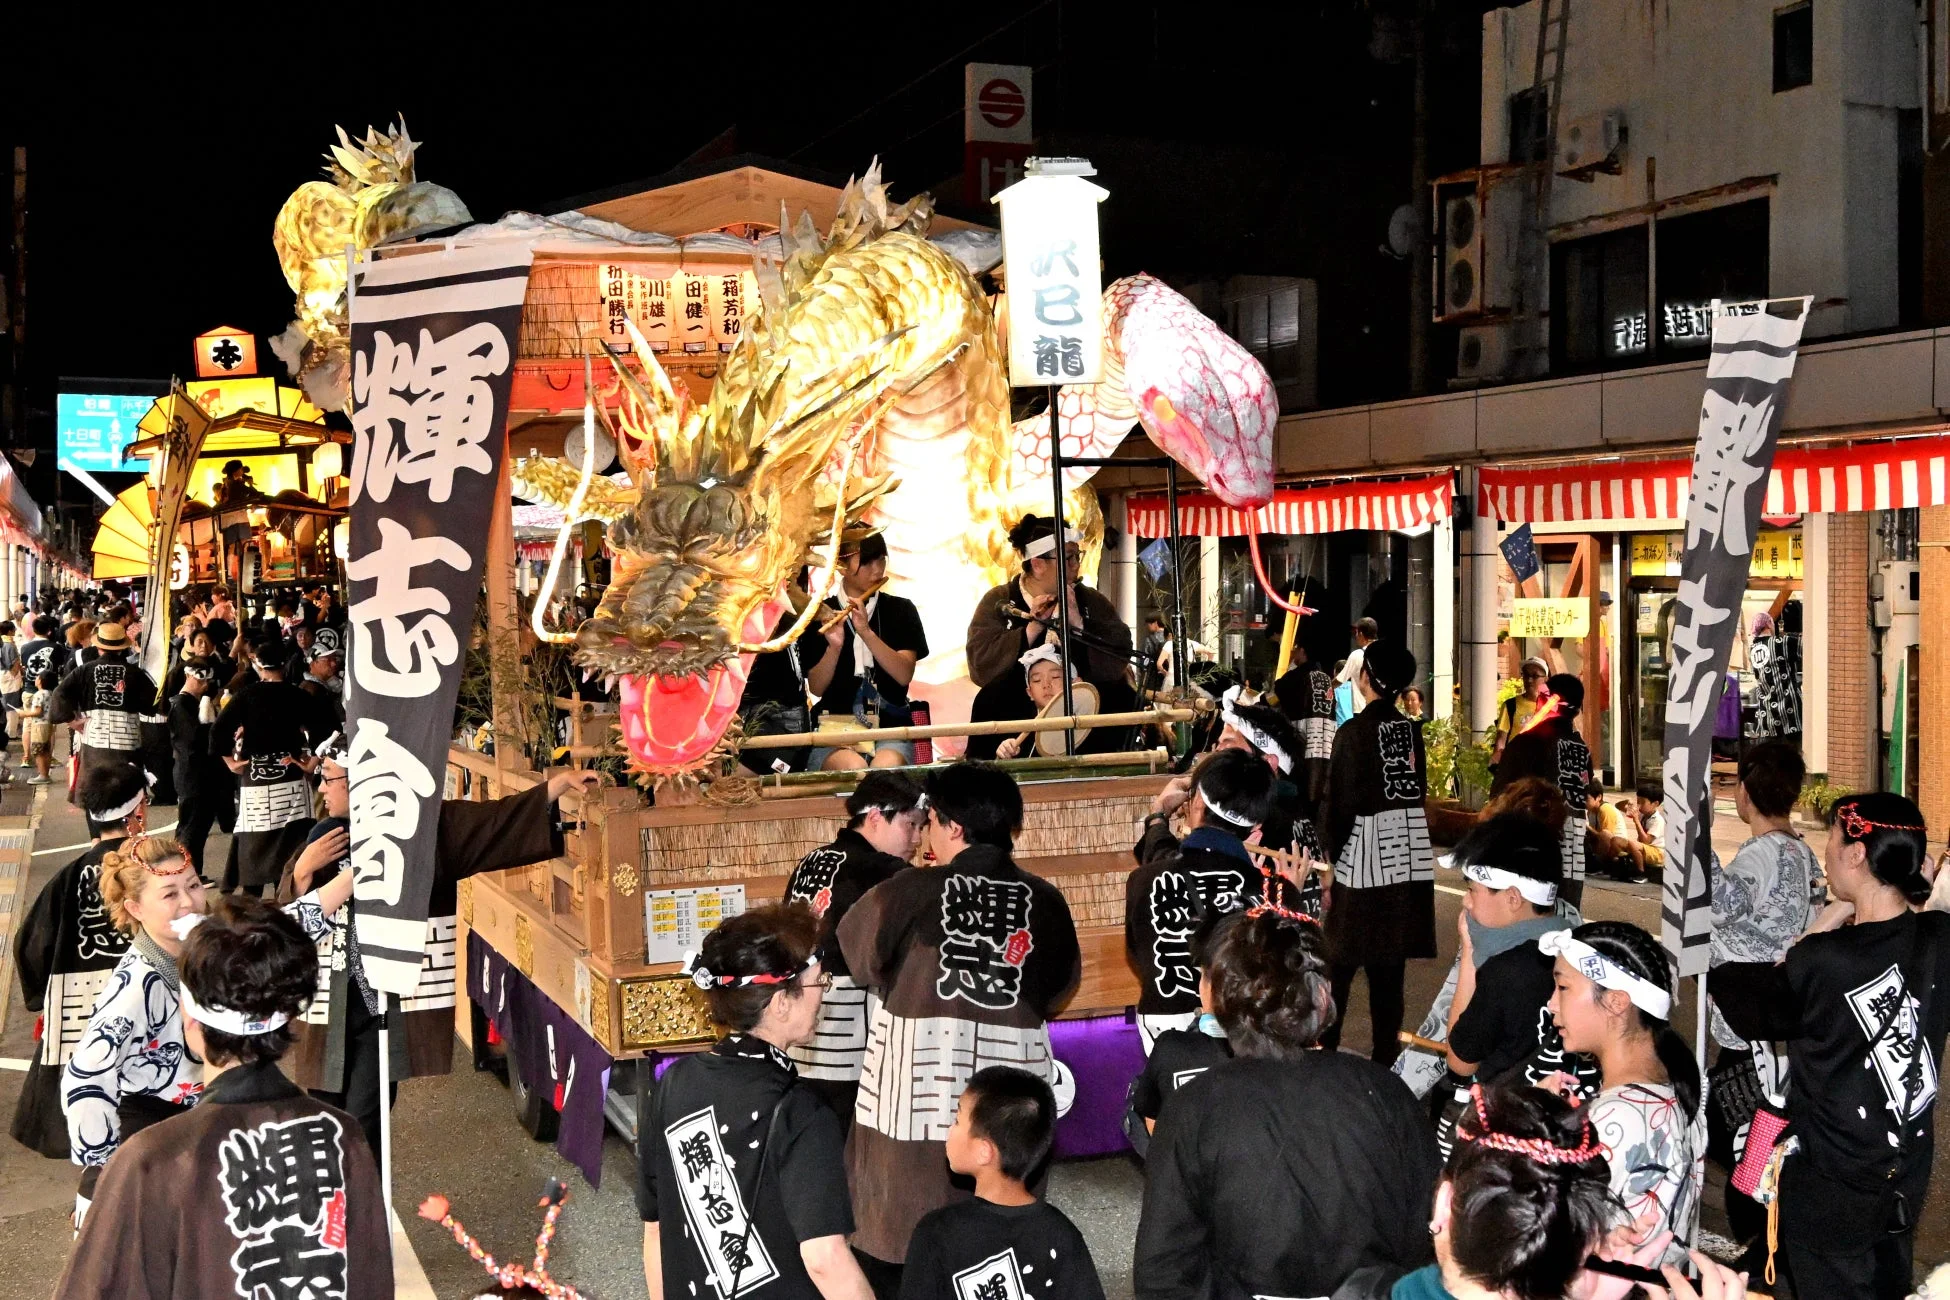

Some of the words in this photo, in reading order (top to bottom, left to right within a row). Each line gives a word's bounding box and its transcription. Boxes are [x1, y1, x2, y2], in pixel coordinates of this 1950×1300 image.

[684, 272, 703, 331] 田健一
[212, 339, 242, 370] 本
[347, 321, 510, 906] 輝志會
[1378, 720, 1420, 800] 輝志
[936, 874, 1033, 1010] 輝志
[1584, 958, 1603, 978] 平沢
[679, 1130, 754, 1276] 輝志會
